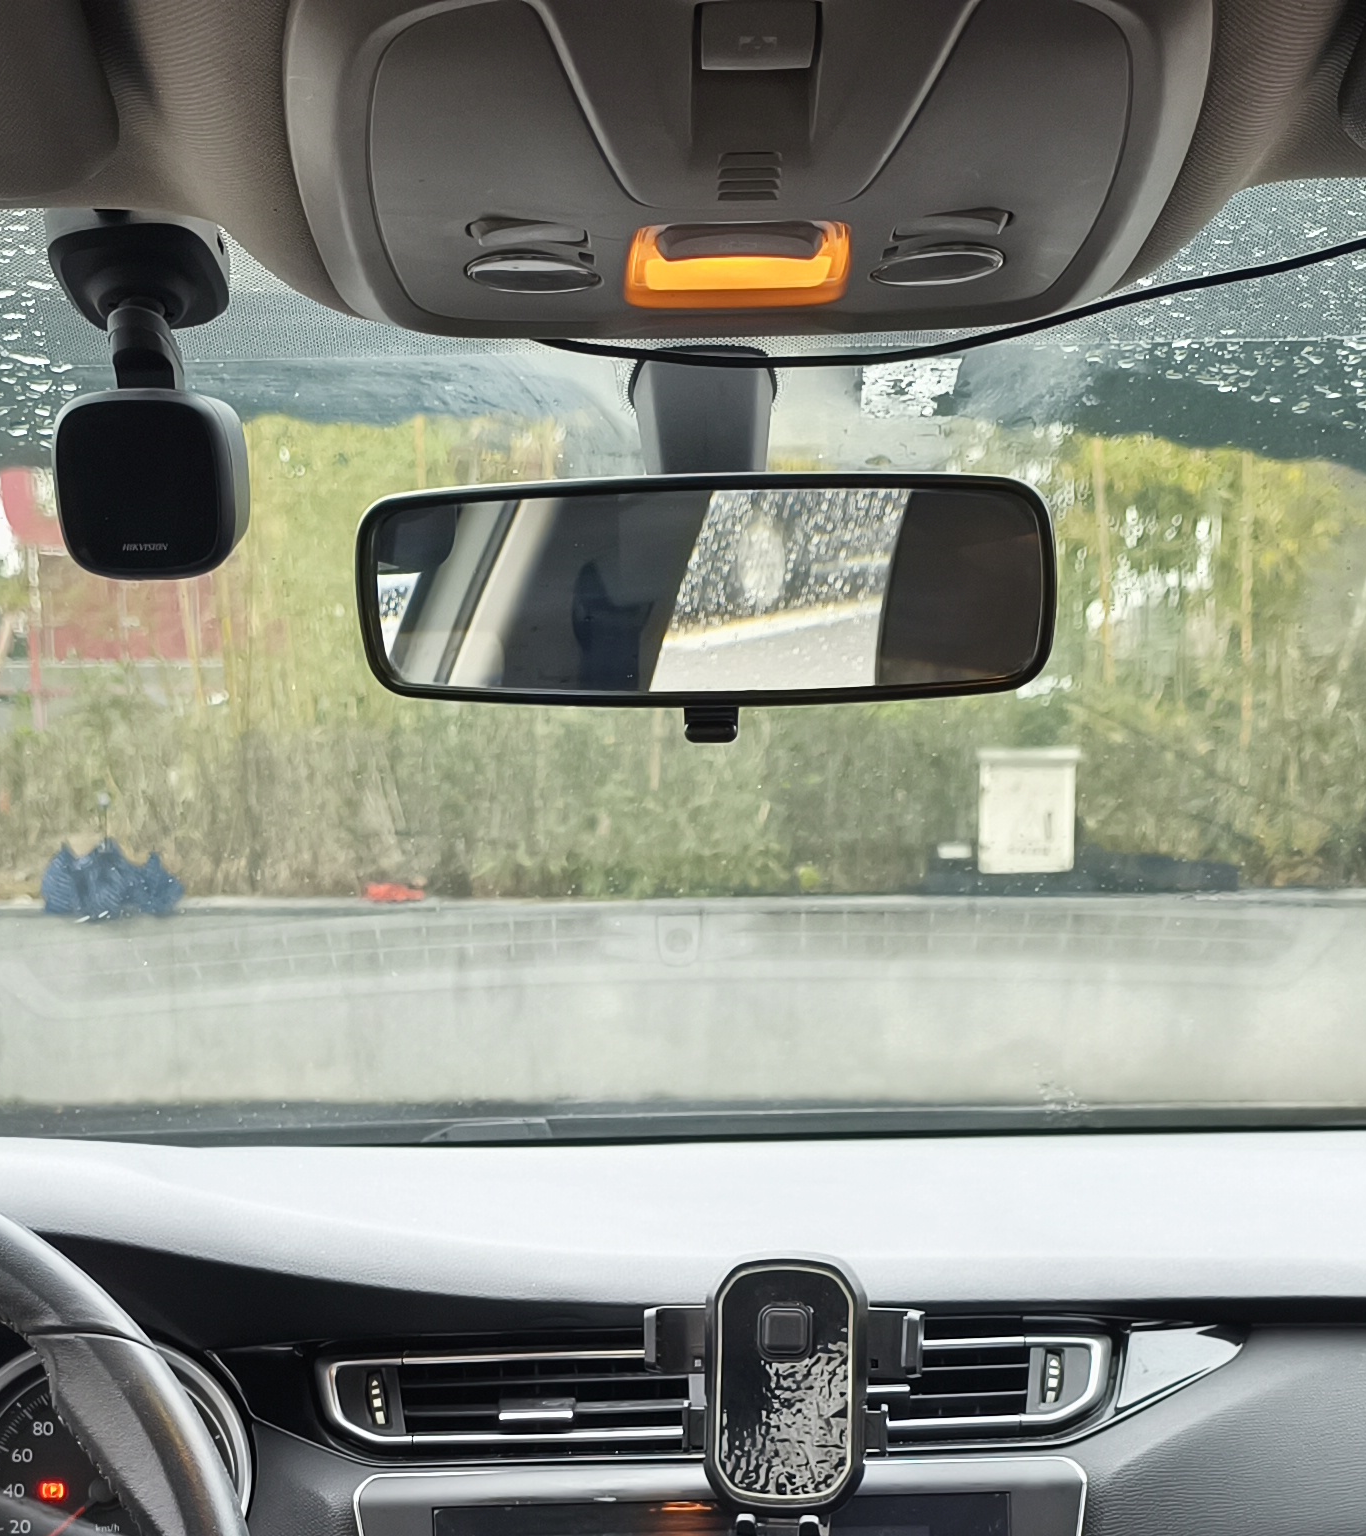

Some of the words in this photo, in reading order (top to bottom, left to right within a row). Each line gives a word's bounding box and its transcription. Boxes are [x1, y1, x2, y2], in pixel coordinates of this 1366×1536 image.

[32, 1421, 54, 1436] 80
[11, 1448, 33, 1463] 60
[3, 1483, 25, 1498] 40
[9, 1519, 31, 1534] 20
[94, 1523, 120, 1533] km/h
